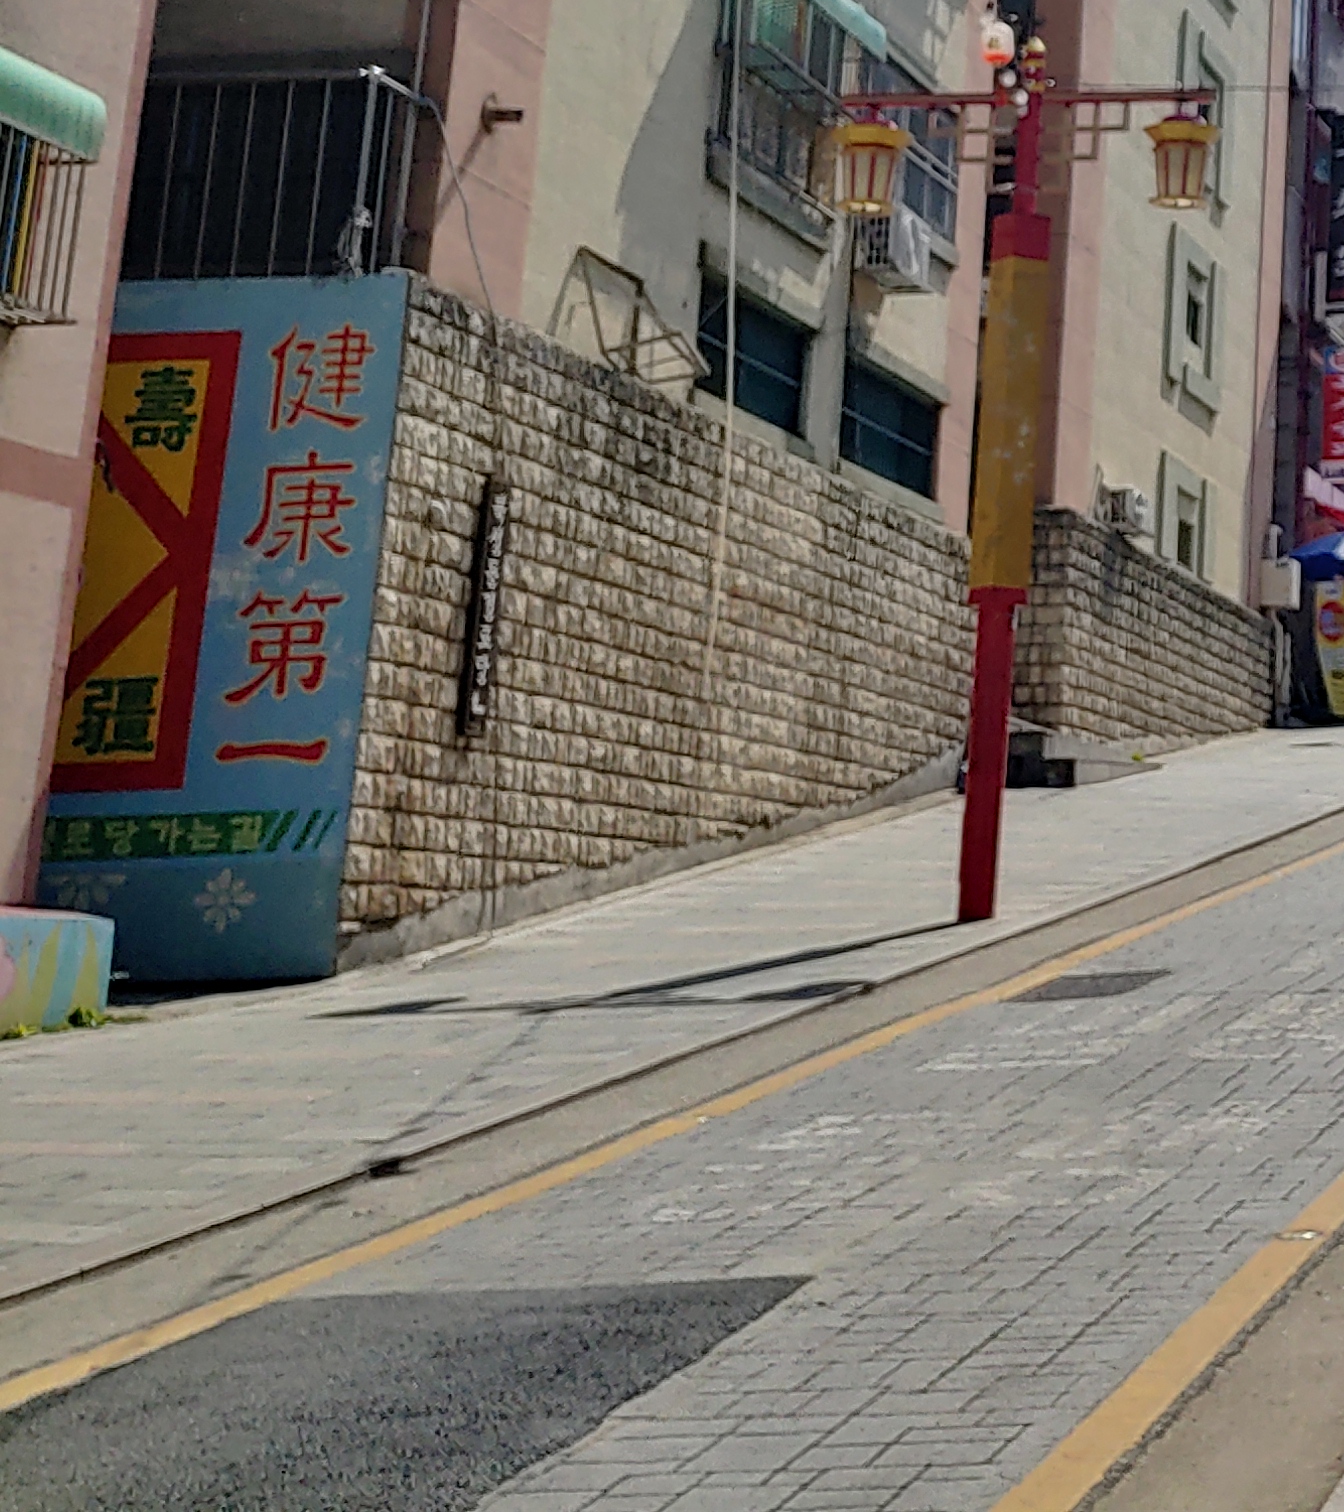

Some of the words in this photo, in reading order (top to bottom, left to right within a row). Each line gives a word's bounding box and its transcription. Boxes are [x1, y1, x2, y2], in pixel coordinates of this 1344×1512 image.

[215, 322, 377, 765] 健康第一
[46, 818, 139, 858] 로당
